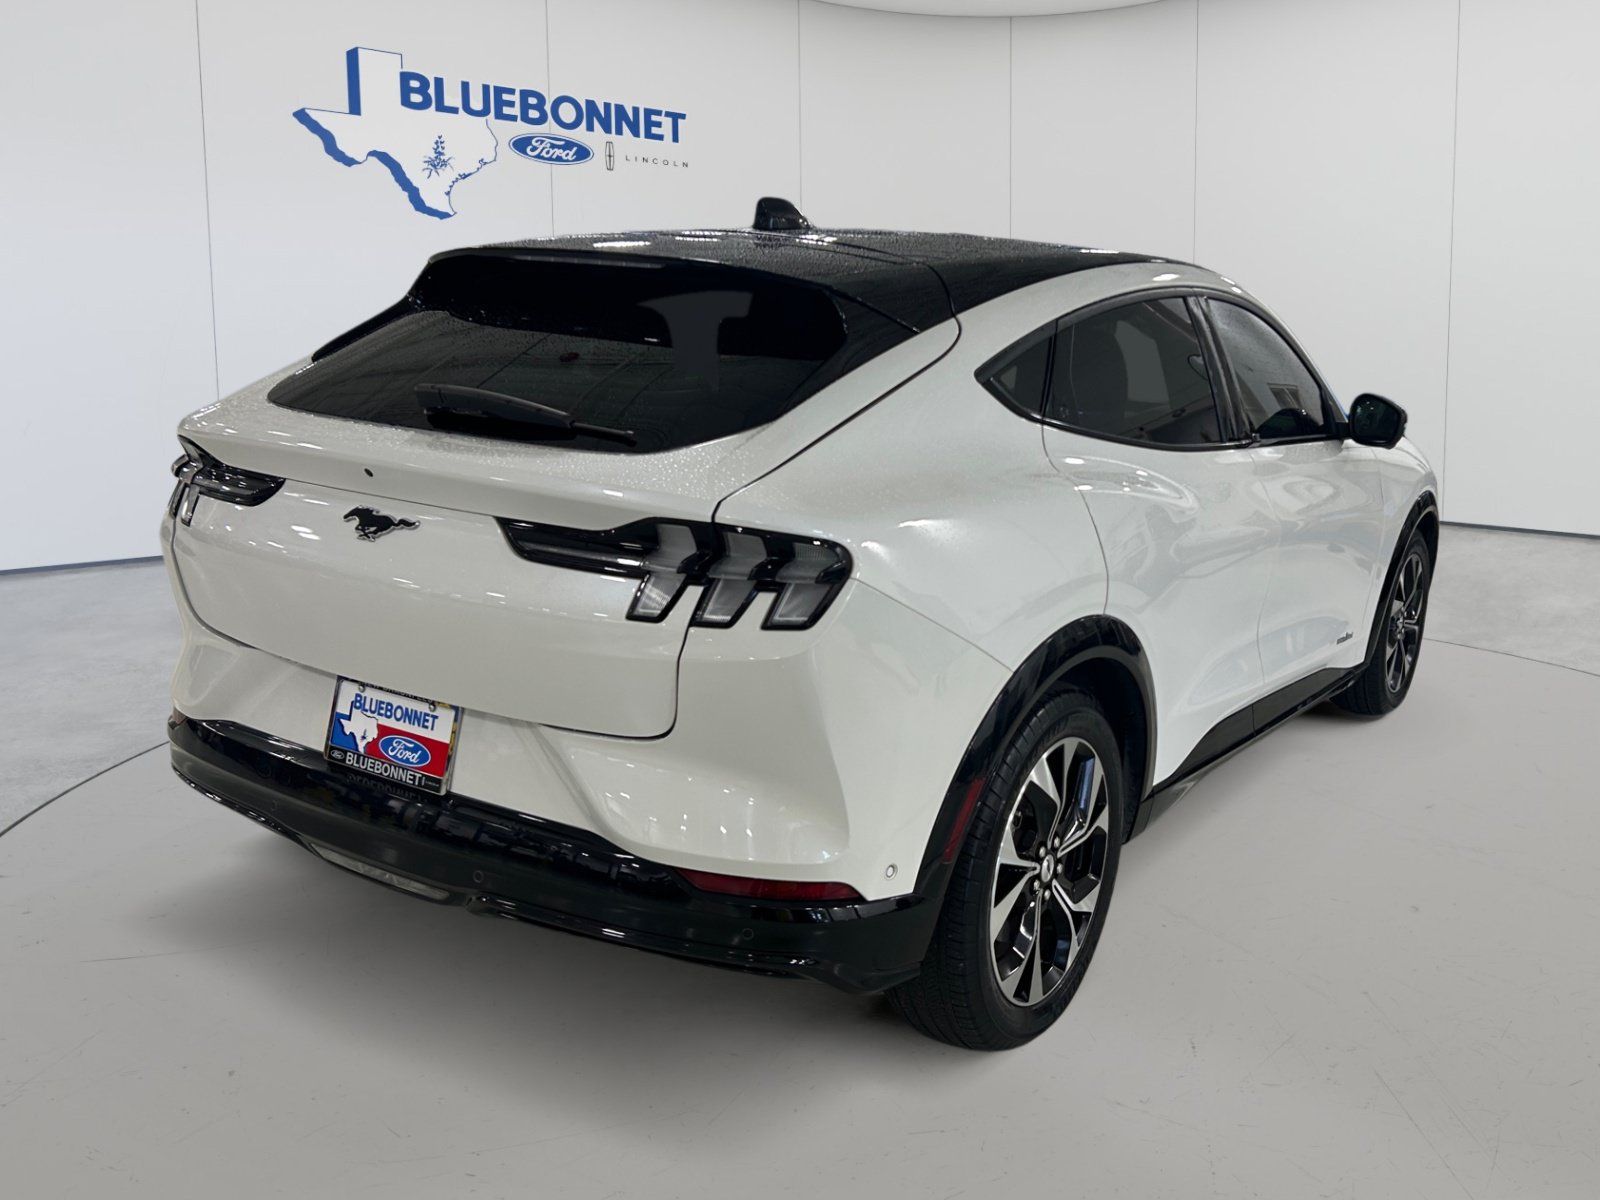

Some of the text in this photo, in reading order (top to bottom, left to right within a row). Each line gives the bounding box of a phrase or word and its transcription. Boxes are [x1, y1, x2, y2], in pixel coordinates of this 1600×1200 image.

[399, 71, 687, 143] BLUEBONNET
[525, 136, 577, 161] Ford
[625, 154, 689, 168] LINCOLN
[353, 693, 439, 731] BLUEBONNET
[387, 738, 422, 764] Ford
[345, 752, 422, 786] BLUEBONNET
